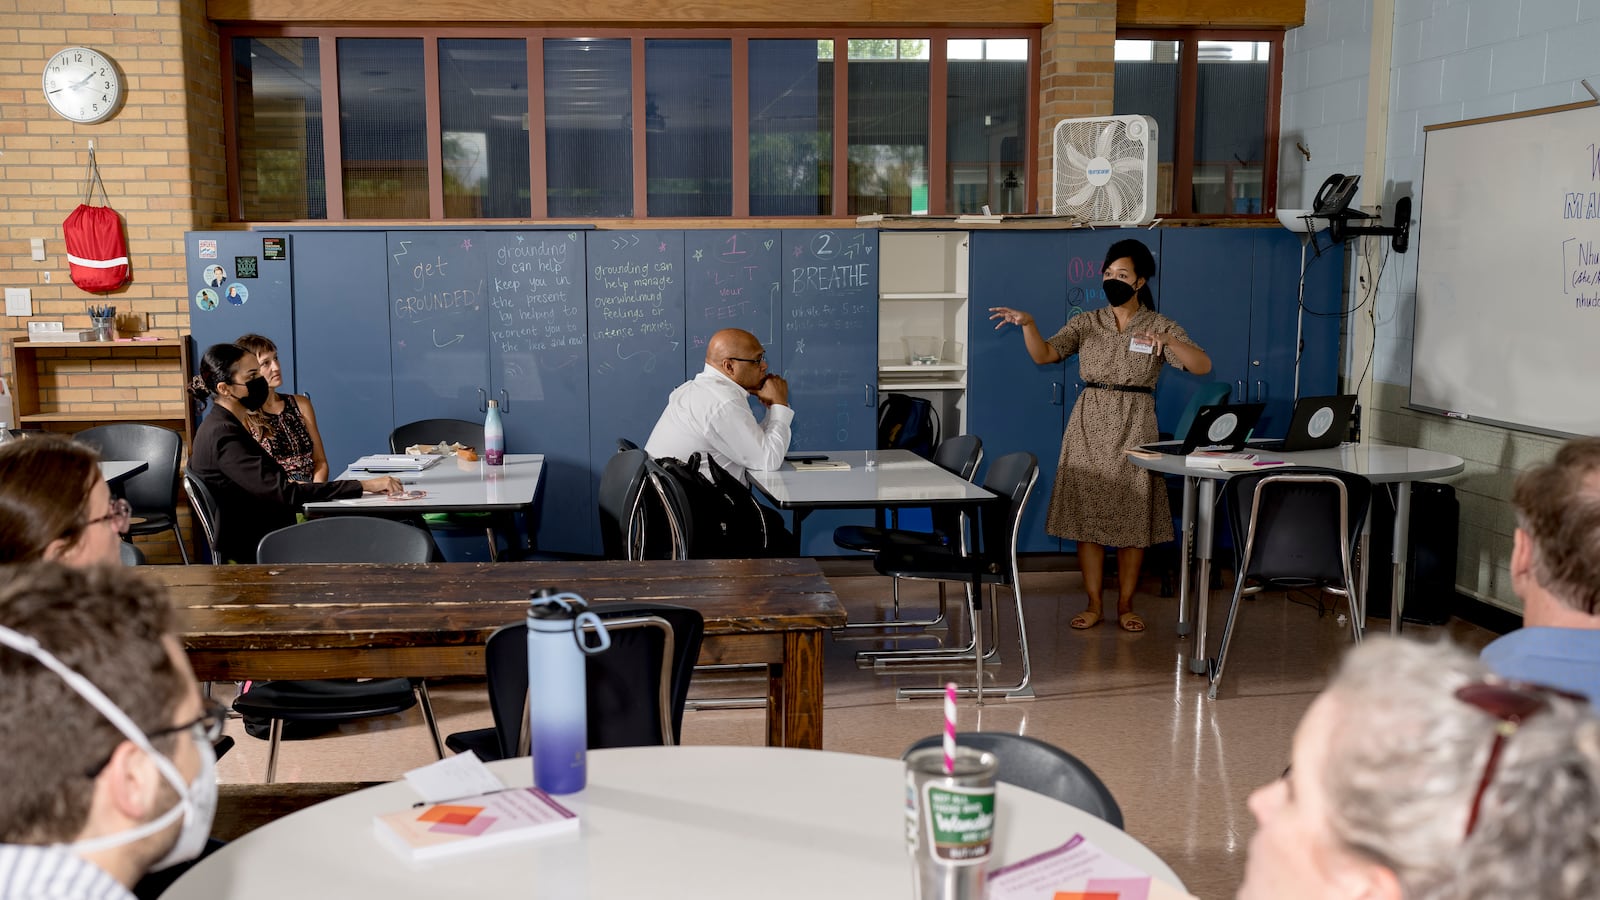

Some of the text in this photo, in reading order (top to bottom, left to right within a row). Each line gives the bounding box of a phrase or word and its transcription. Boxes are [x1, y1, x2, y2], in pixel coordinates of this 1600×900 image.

[62, 57, 69, 66] 11
[74, 54, 82, 62] 12
[100, 68, 105, 77] 2
[104, 81, 110, 89] 3
[102, 94, 107, 103] 4
[497, 241, 567, 265] grounding
[722, 234, 748, 256] 1
[816, 234, 833, 255] 2
[413, 256, 448, 292] get
[512, 259, 562, 275] can help
[594, 261, 673, 280] grounding can
[494, 275, 571, 293] keep you in
[604, 275, 674, 290] help manage
[792, 263, 870, 294] BREATHE
[492, 292, 567, 309] the present
[594, 290, 663, 308] overwhelming
[499, 305, 578, 326] by helping to
[603, 306, 665, 321] feelings or
[544, 325, 561, 338] you
[593, 318, 676, 341] intense anxiety
[502, 341, 518, 353] the
